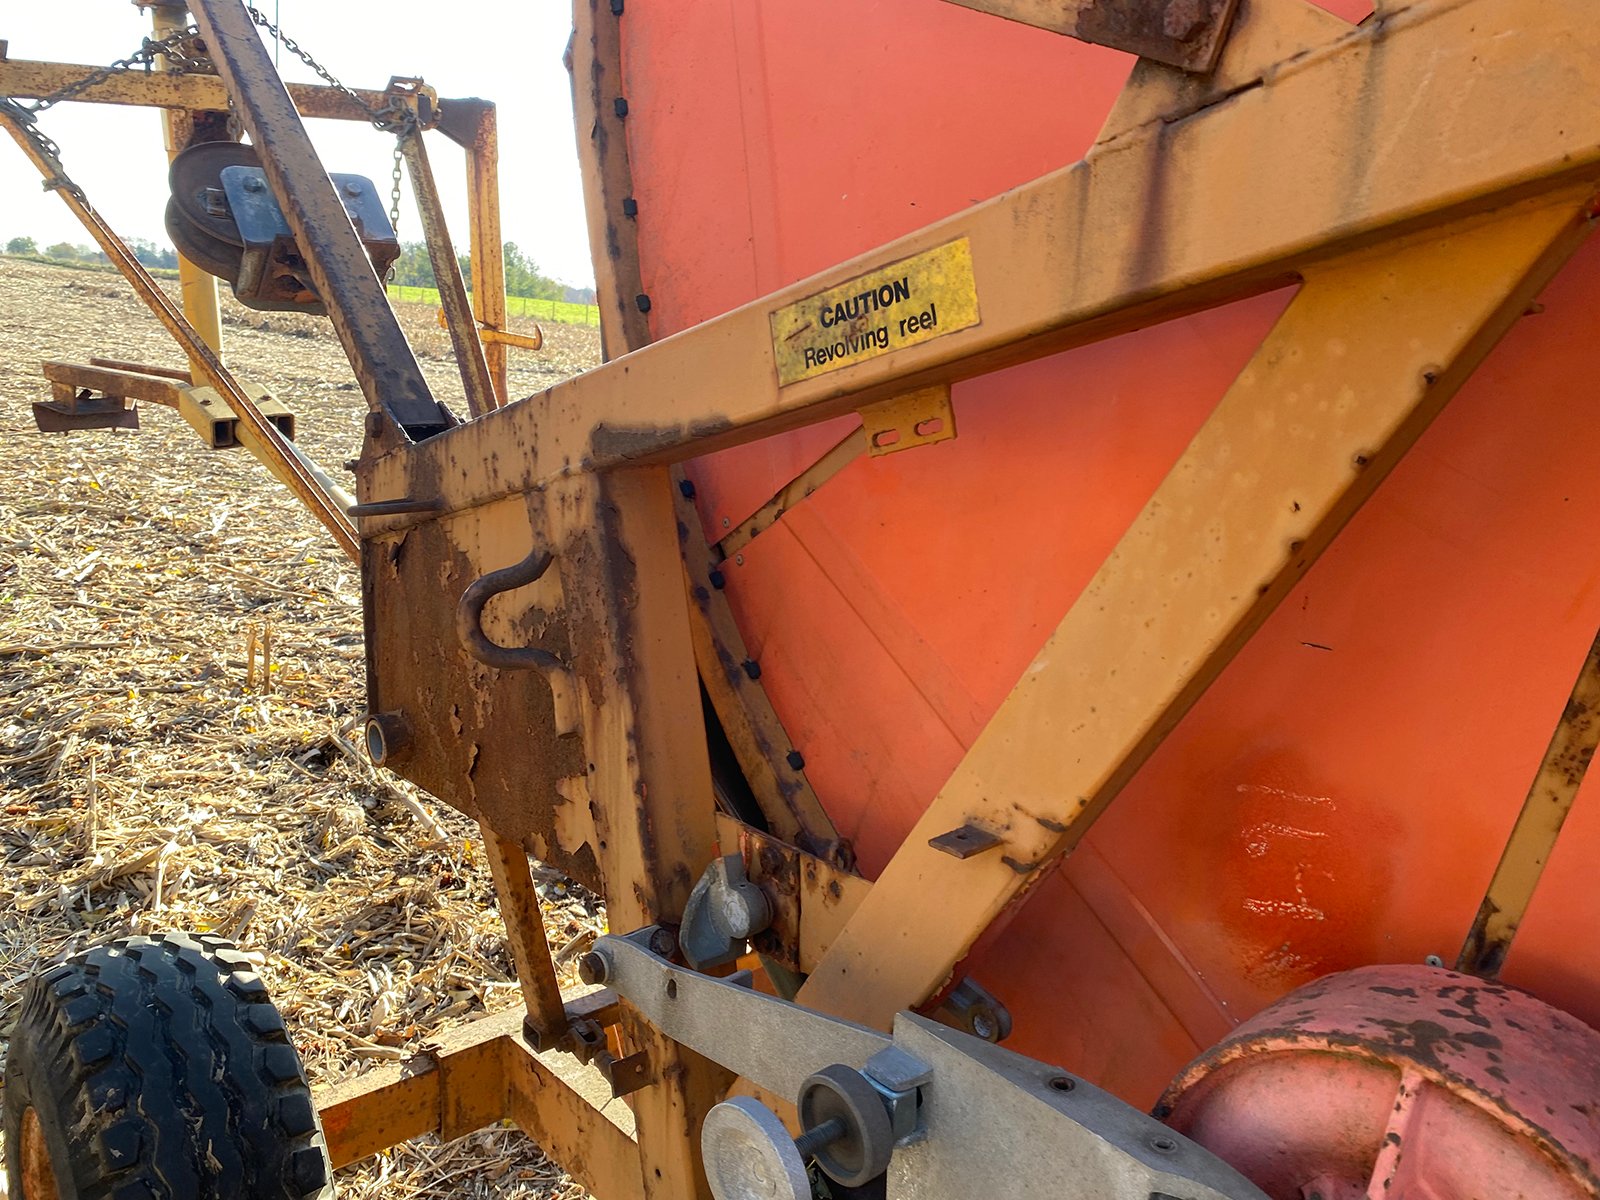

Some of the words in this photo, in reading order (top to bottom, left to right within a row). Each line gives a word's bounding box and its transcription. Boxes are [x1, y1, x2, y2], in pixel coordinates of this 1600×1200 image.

[820, 277, 910, 328] CAUTION
[804, 326, 889, 369] Revolving
[899, 303, 938, 336] reel
